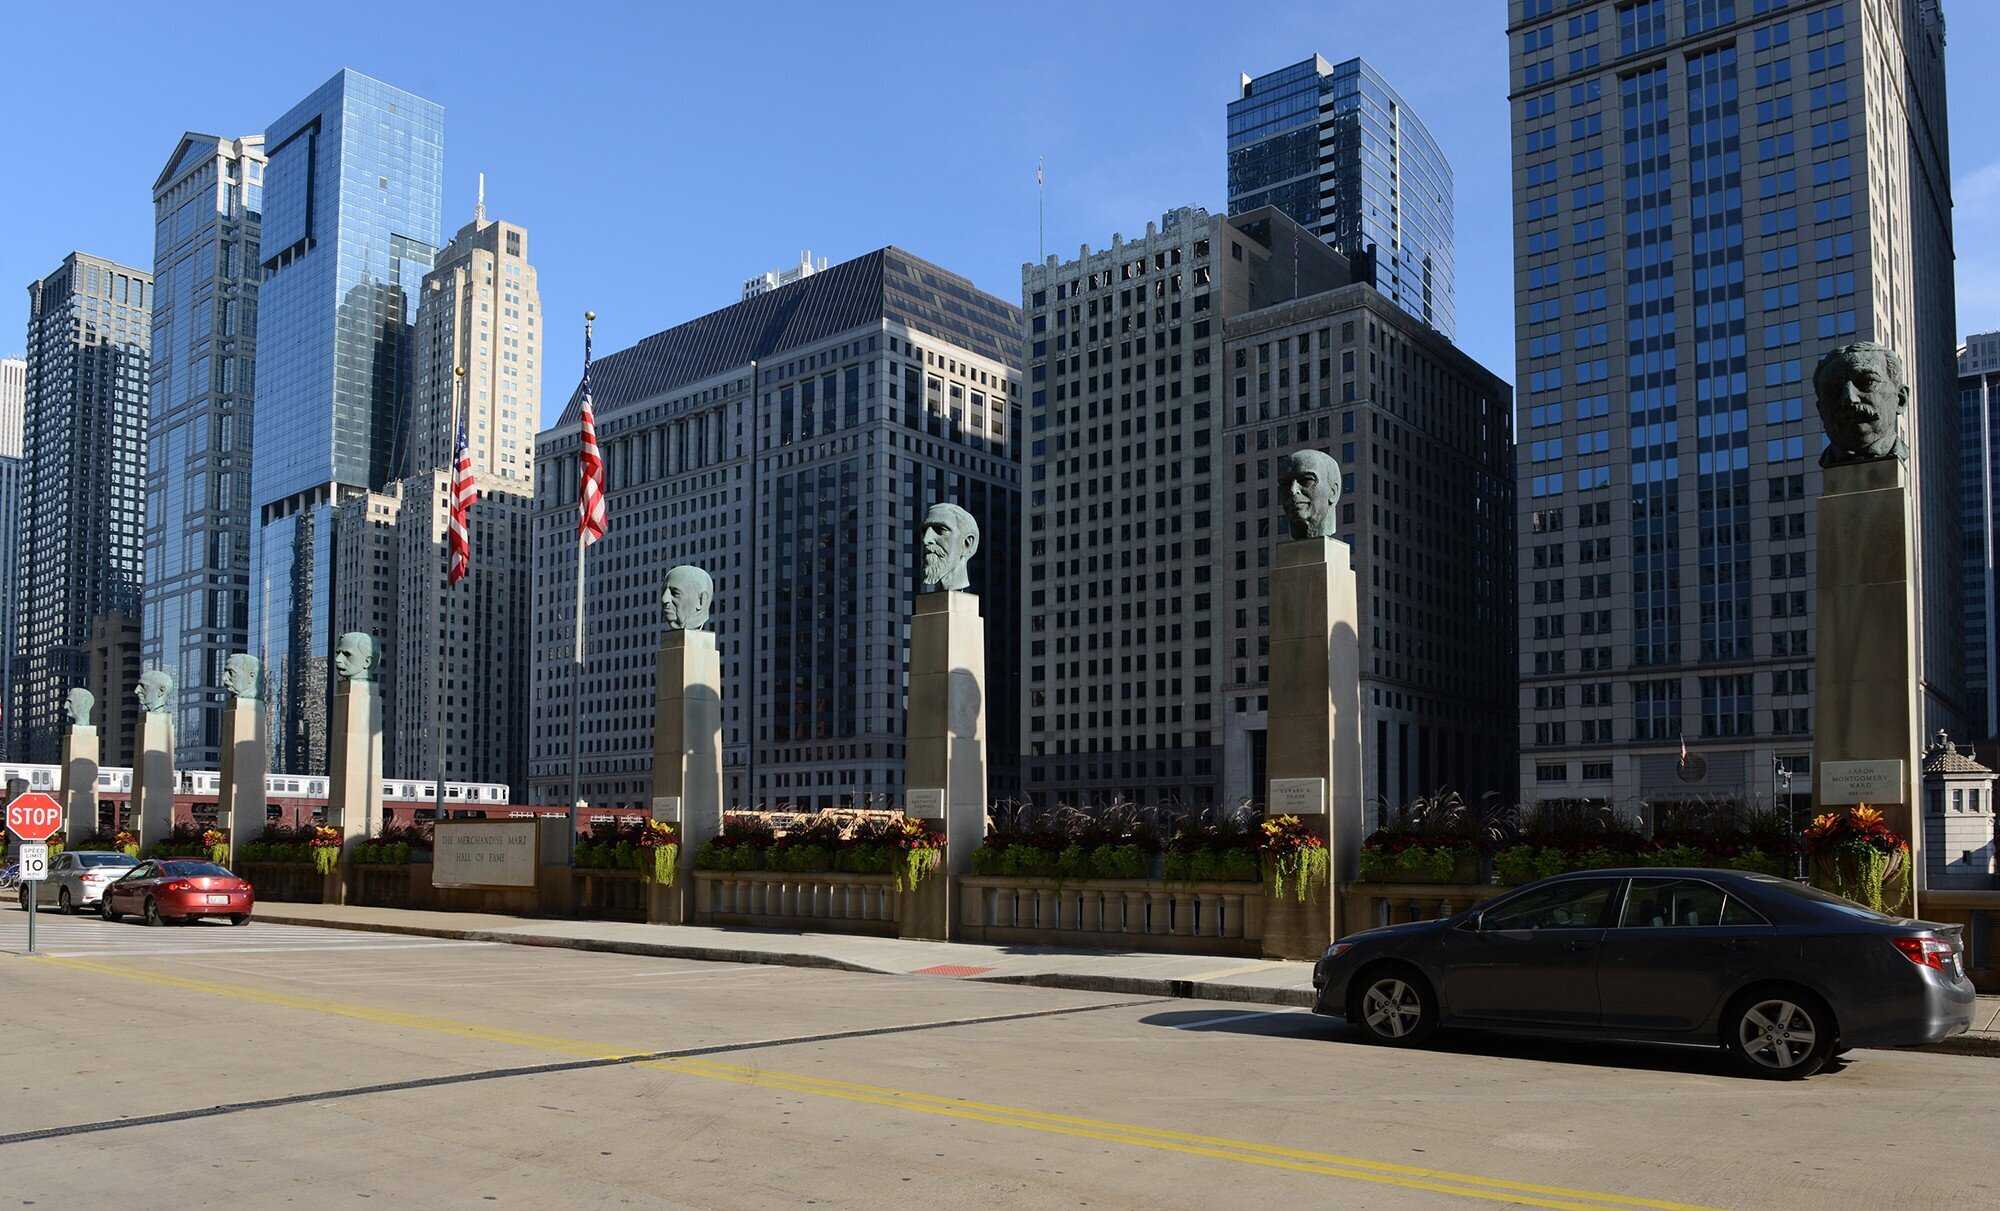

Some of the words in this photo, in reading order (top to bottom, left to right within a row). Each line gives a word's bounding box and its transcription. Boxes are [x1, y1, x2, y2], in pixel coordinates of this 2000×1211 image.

[11, 807, 59, 826] STOP
[508, 835, 527, 845] MART
[456, 852, 472, 862] HALL
[25, 859, 44, 872] 10
